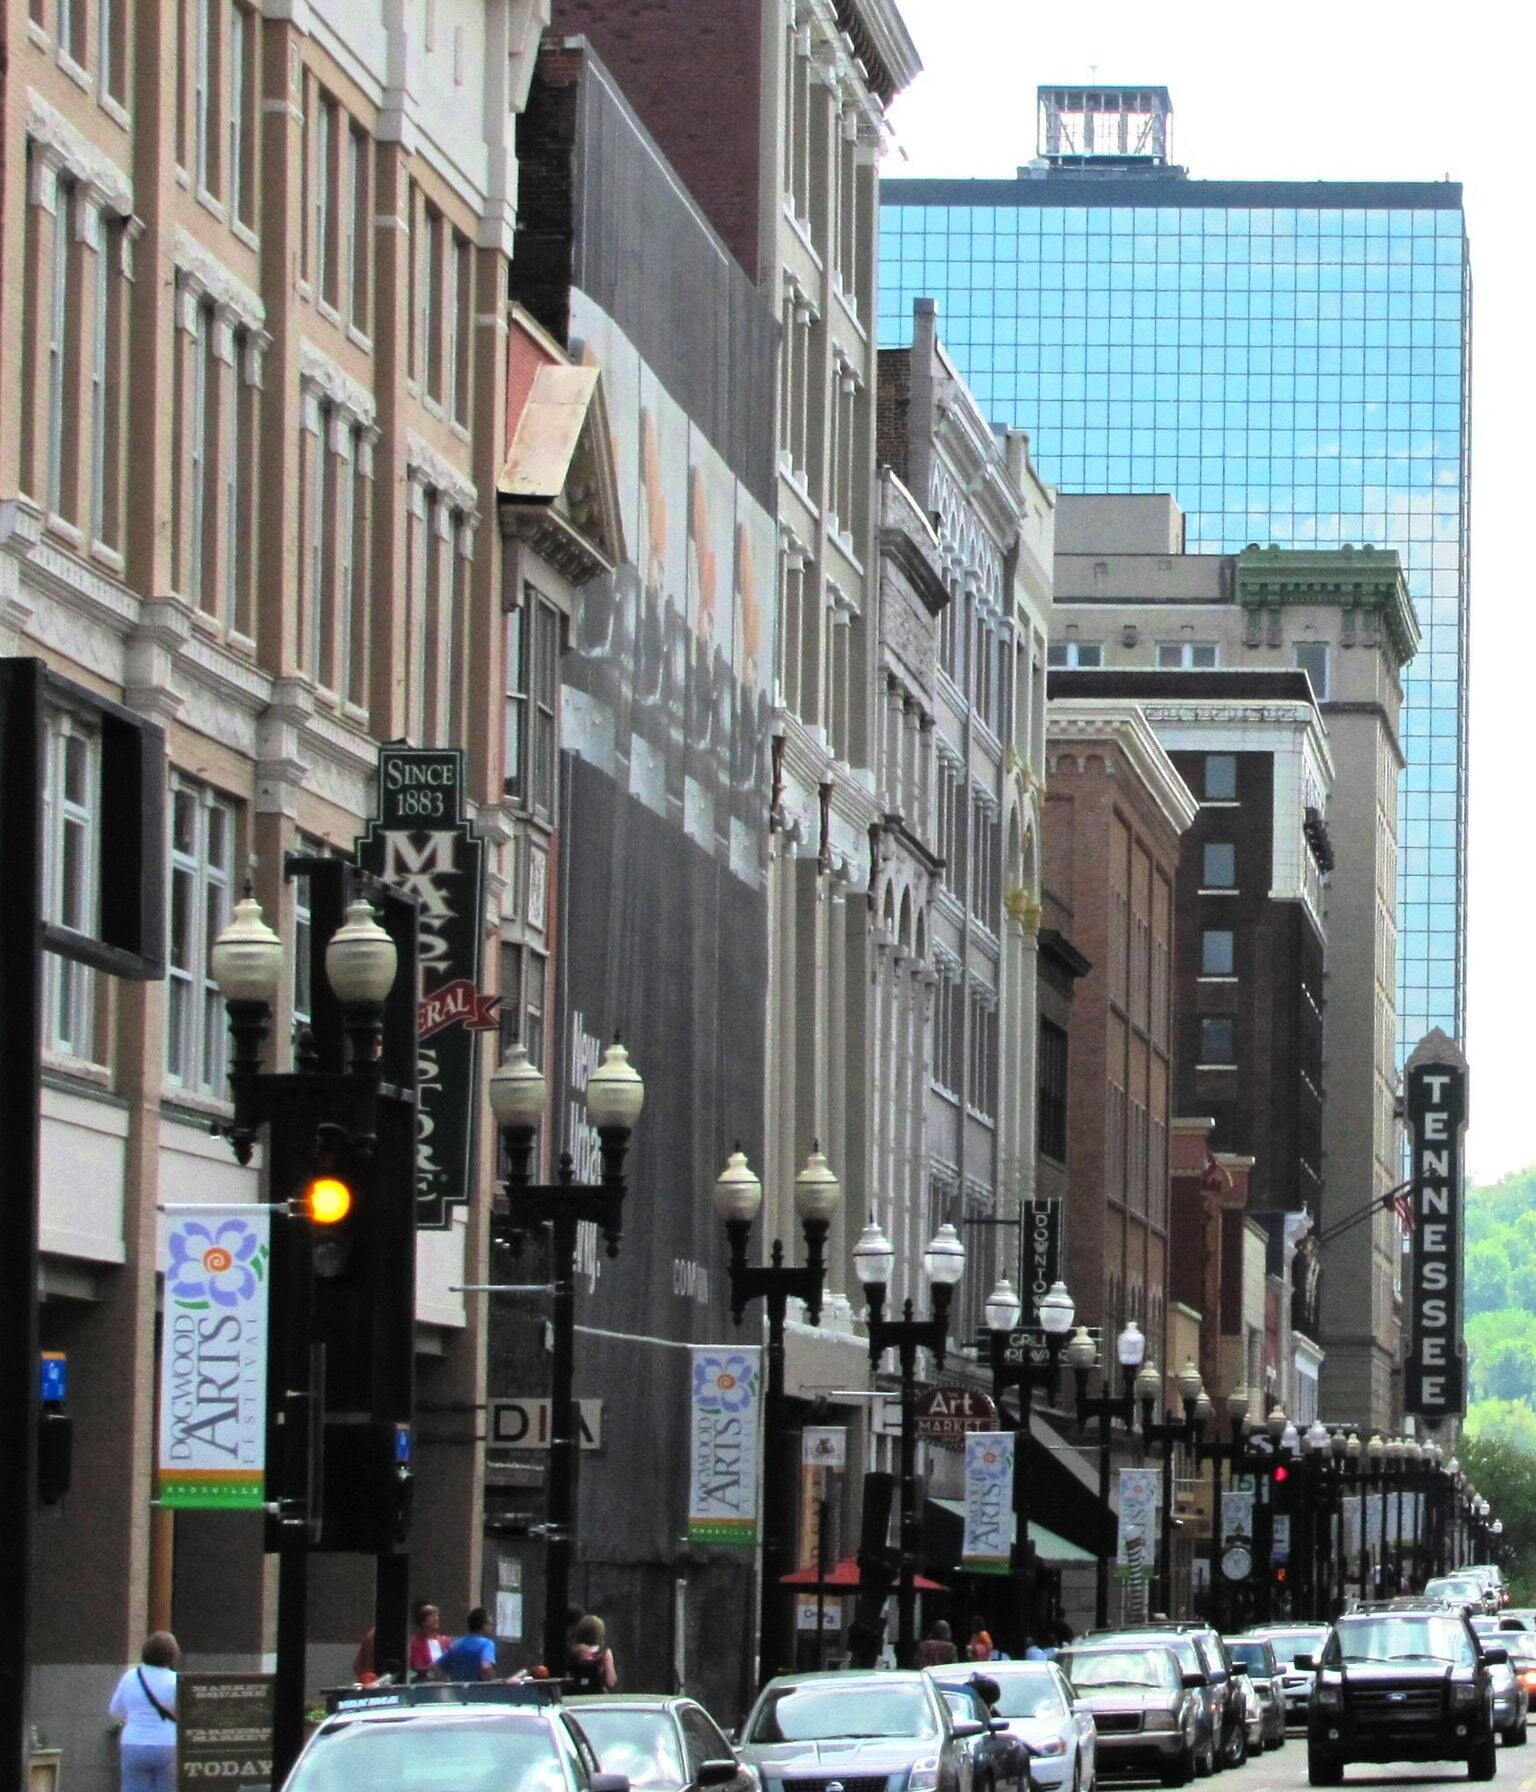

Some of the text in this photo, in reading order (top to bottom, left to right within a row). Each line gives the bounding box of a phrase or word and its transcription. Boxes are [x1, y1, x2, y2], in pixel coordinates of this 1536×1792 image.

[387, 760, 455, 789] SINCE
[396, 792, 444, 818] 1883
[1421, 1074, 1450, 1405] TENNESSEE
[170, 1314, 195, 1461] DOGWOOD
[180, 1315, 242, 1460] ARTS
[928, 1391, 974, 1416] Art
[918, 1420, 982, 1433] MARKET
[703, 1418, 742, 1513] ARTS
[184, 1760, 273, 1777] TODAY
